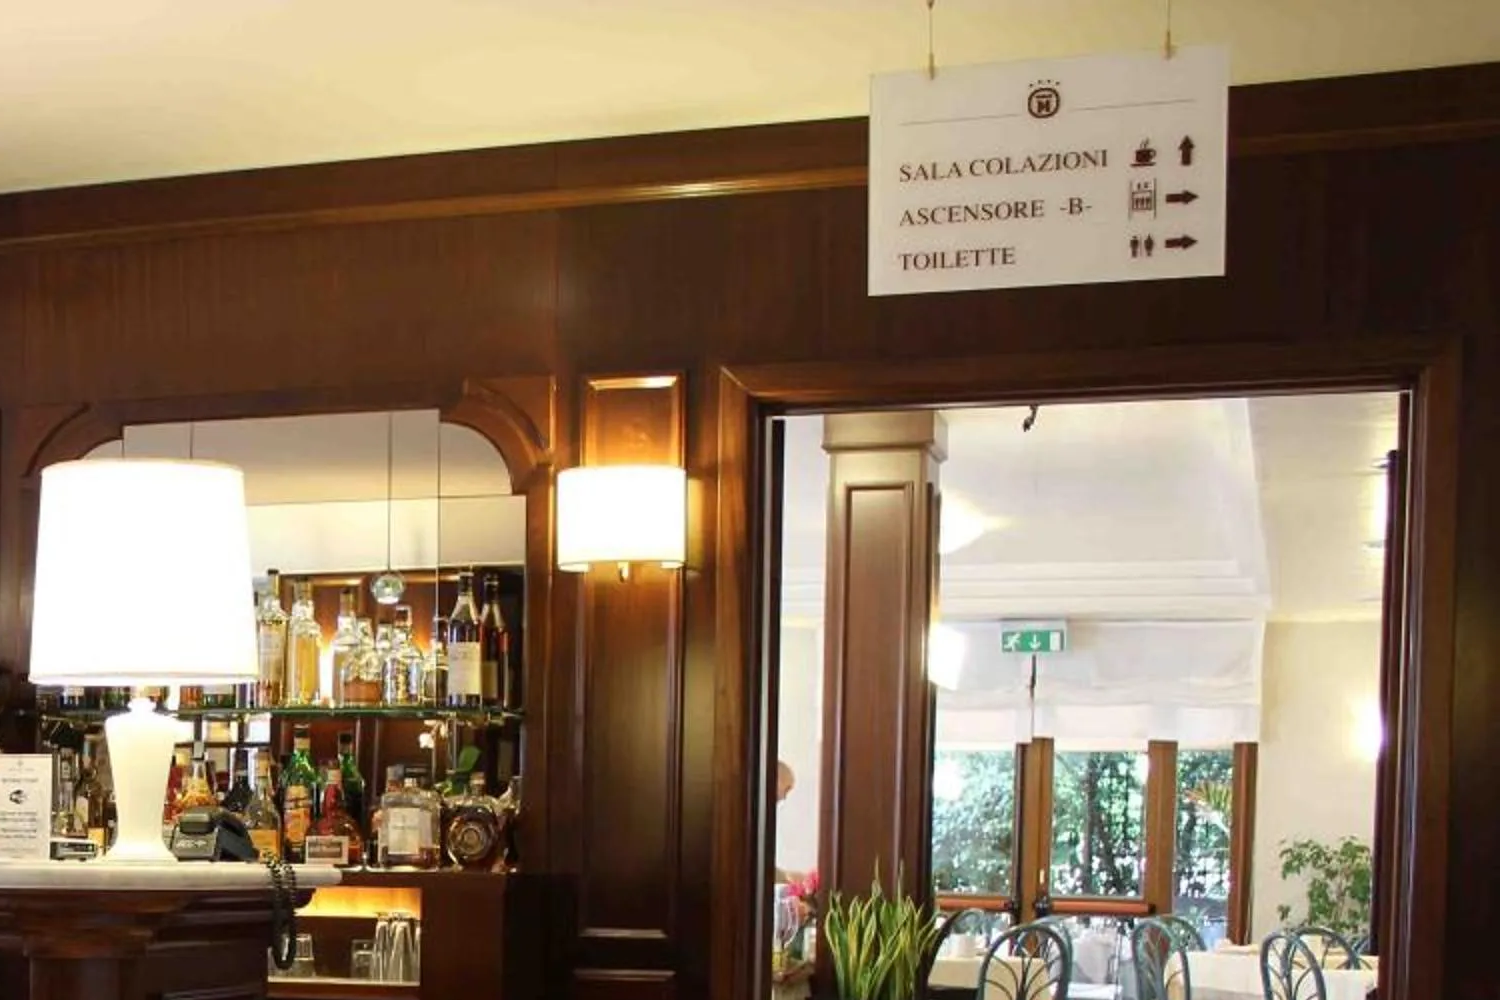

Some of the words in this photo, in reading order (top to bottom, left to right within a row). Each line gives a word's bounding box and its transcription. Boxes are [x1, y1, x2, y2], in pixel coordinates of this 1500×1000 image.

[899, 162, 962, 182] SALA
[969, 148, 1109, 175] COLAZIONI
[899, 199, 1046, 227] ASCENSORE
[899, 246, 1017, 271] TOILETTE
